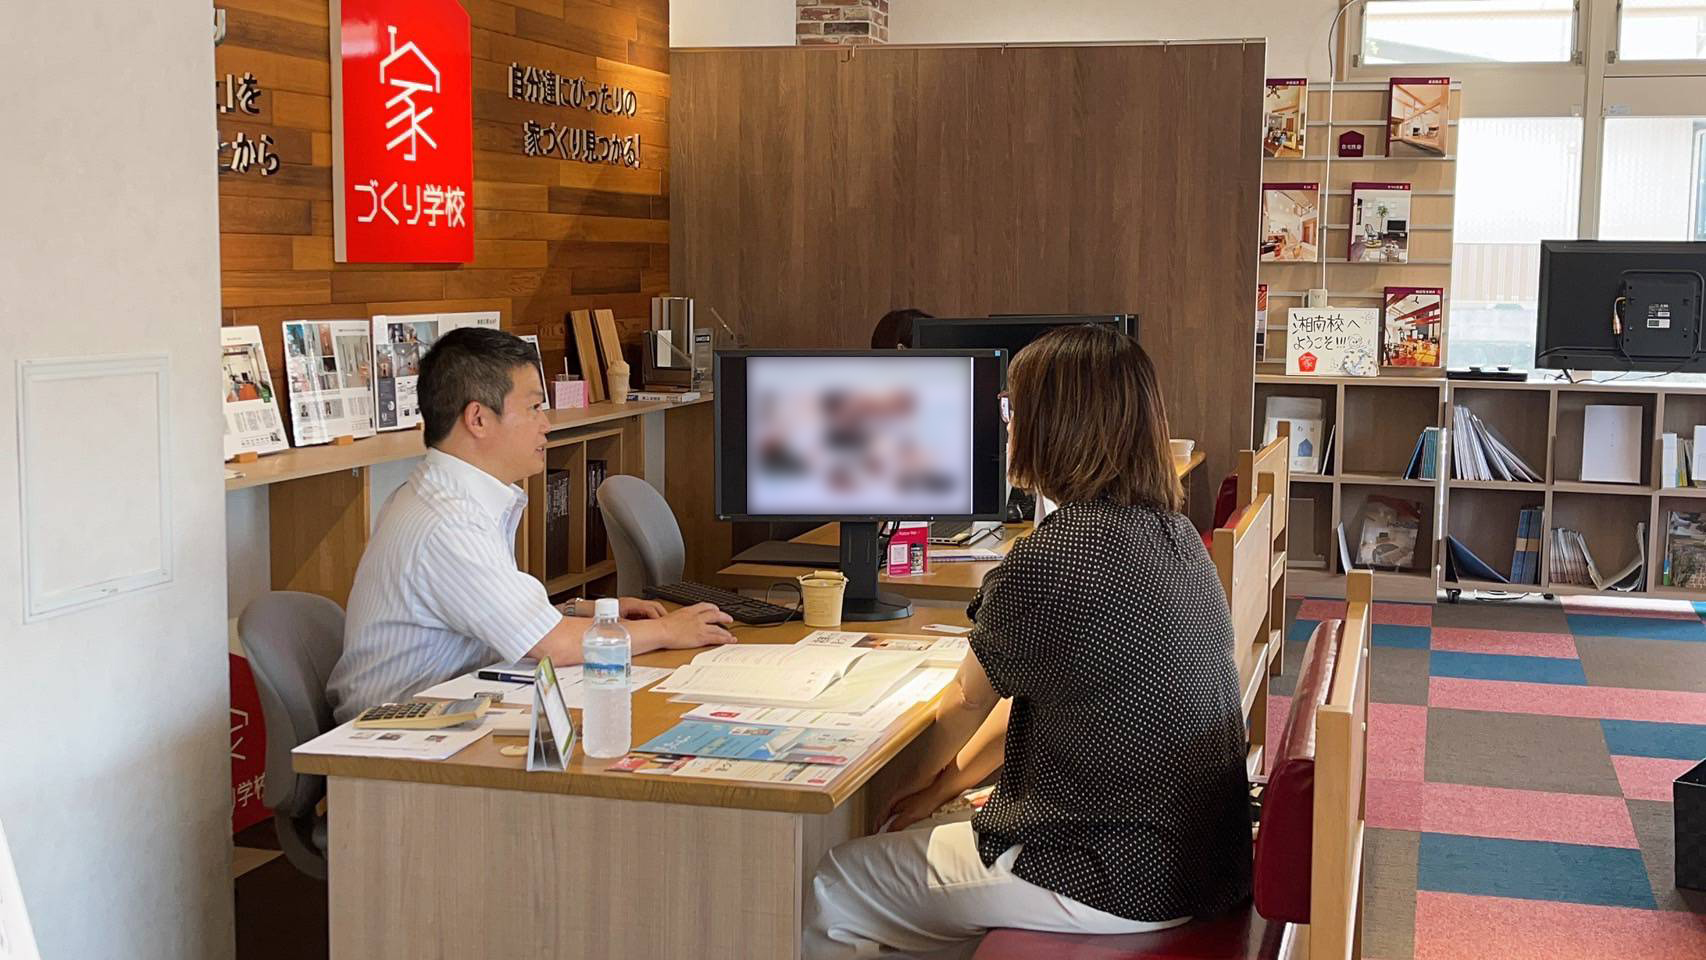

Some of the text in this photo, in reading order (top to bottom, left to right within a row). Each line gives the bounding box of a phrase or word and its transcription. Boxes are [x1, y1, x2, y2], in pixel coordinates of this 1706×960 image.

[380, 26, 440, 161] 家
[523, 119, 640, 169] 家づくり見つかる!
[354, 179, 466, 228] づくり学校
[1292, 313, 1361, 335] 湘南校へ
